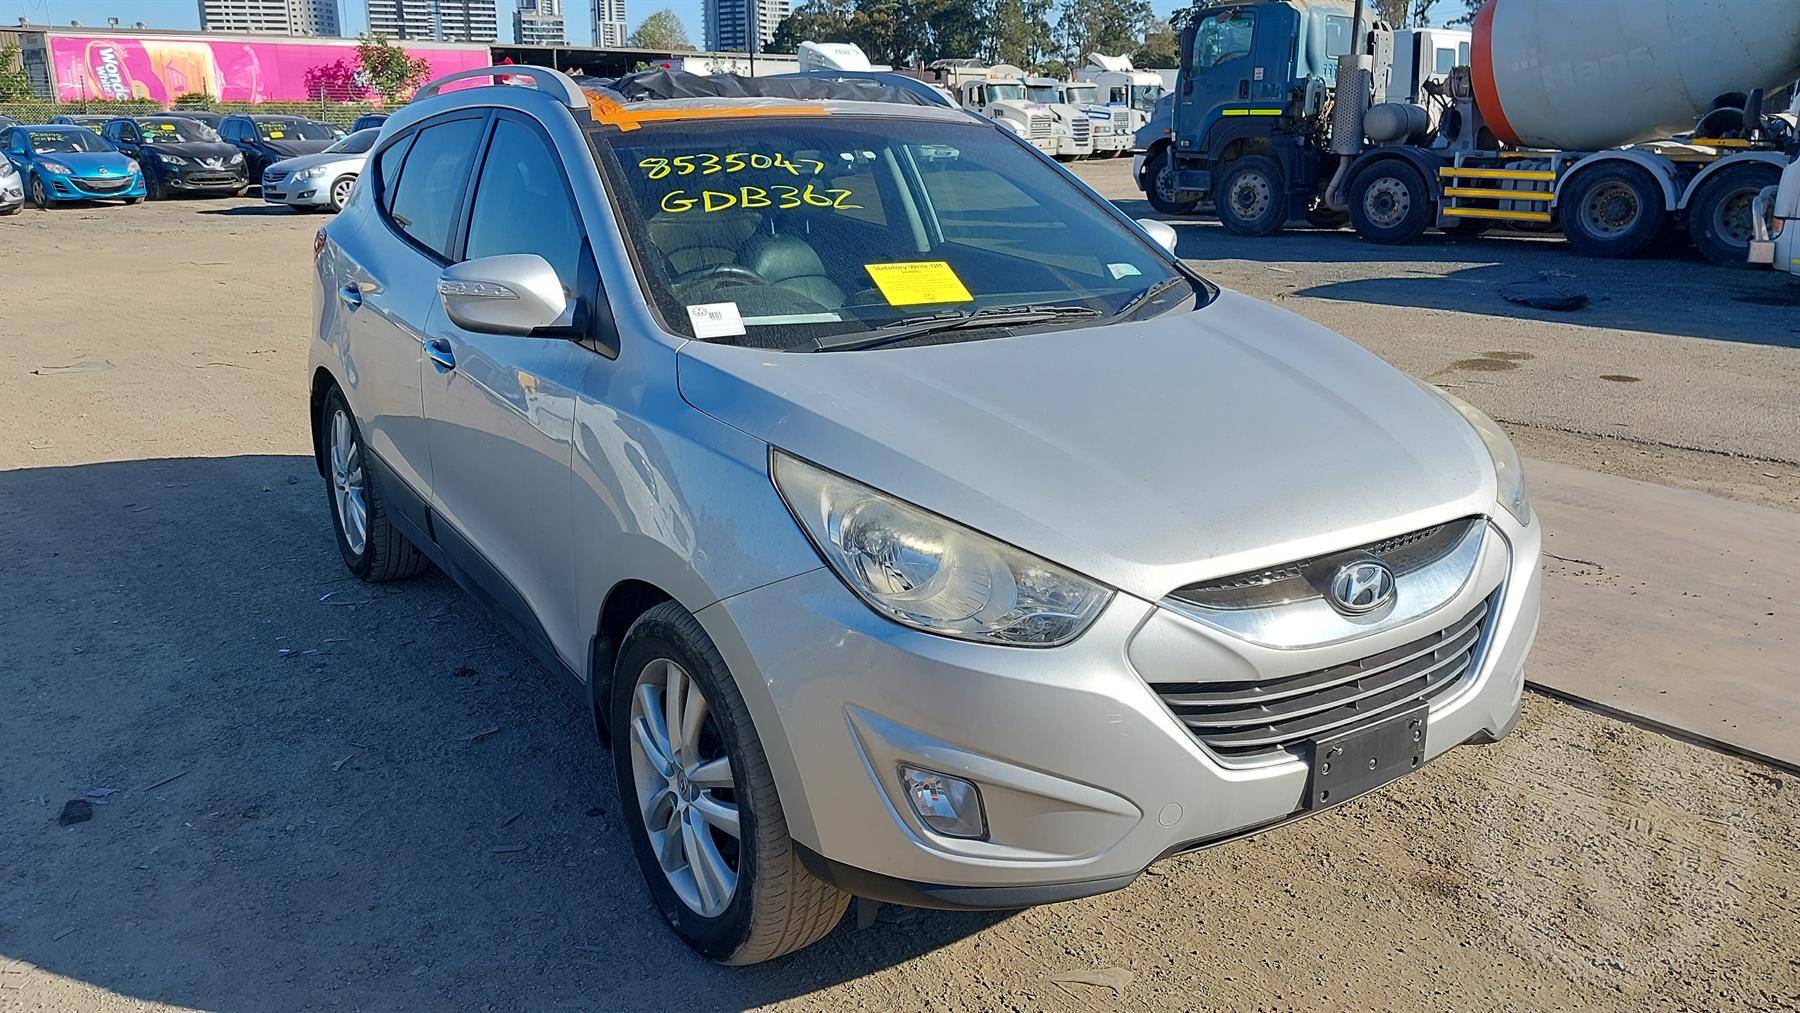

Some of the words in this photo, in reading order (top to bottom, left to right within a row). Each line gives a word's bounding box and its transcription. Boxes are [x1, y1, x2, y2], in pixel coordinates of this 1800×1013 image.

[96, 66, 112, 94] White
[99, 47, 131, 100] Wonde
[638, 152, 824, 179] 8535047
[660, 184, 864, 213] GDB362
